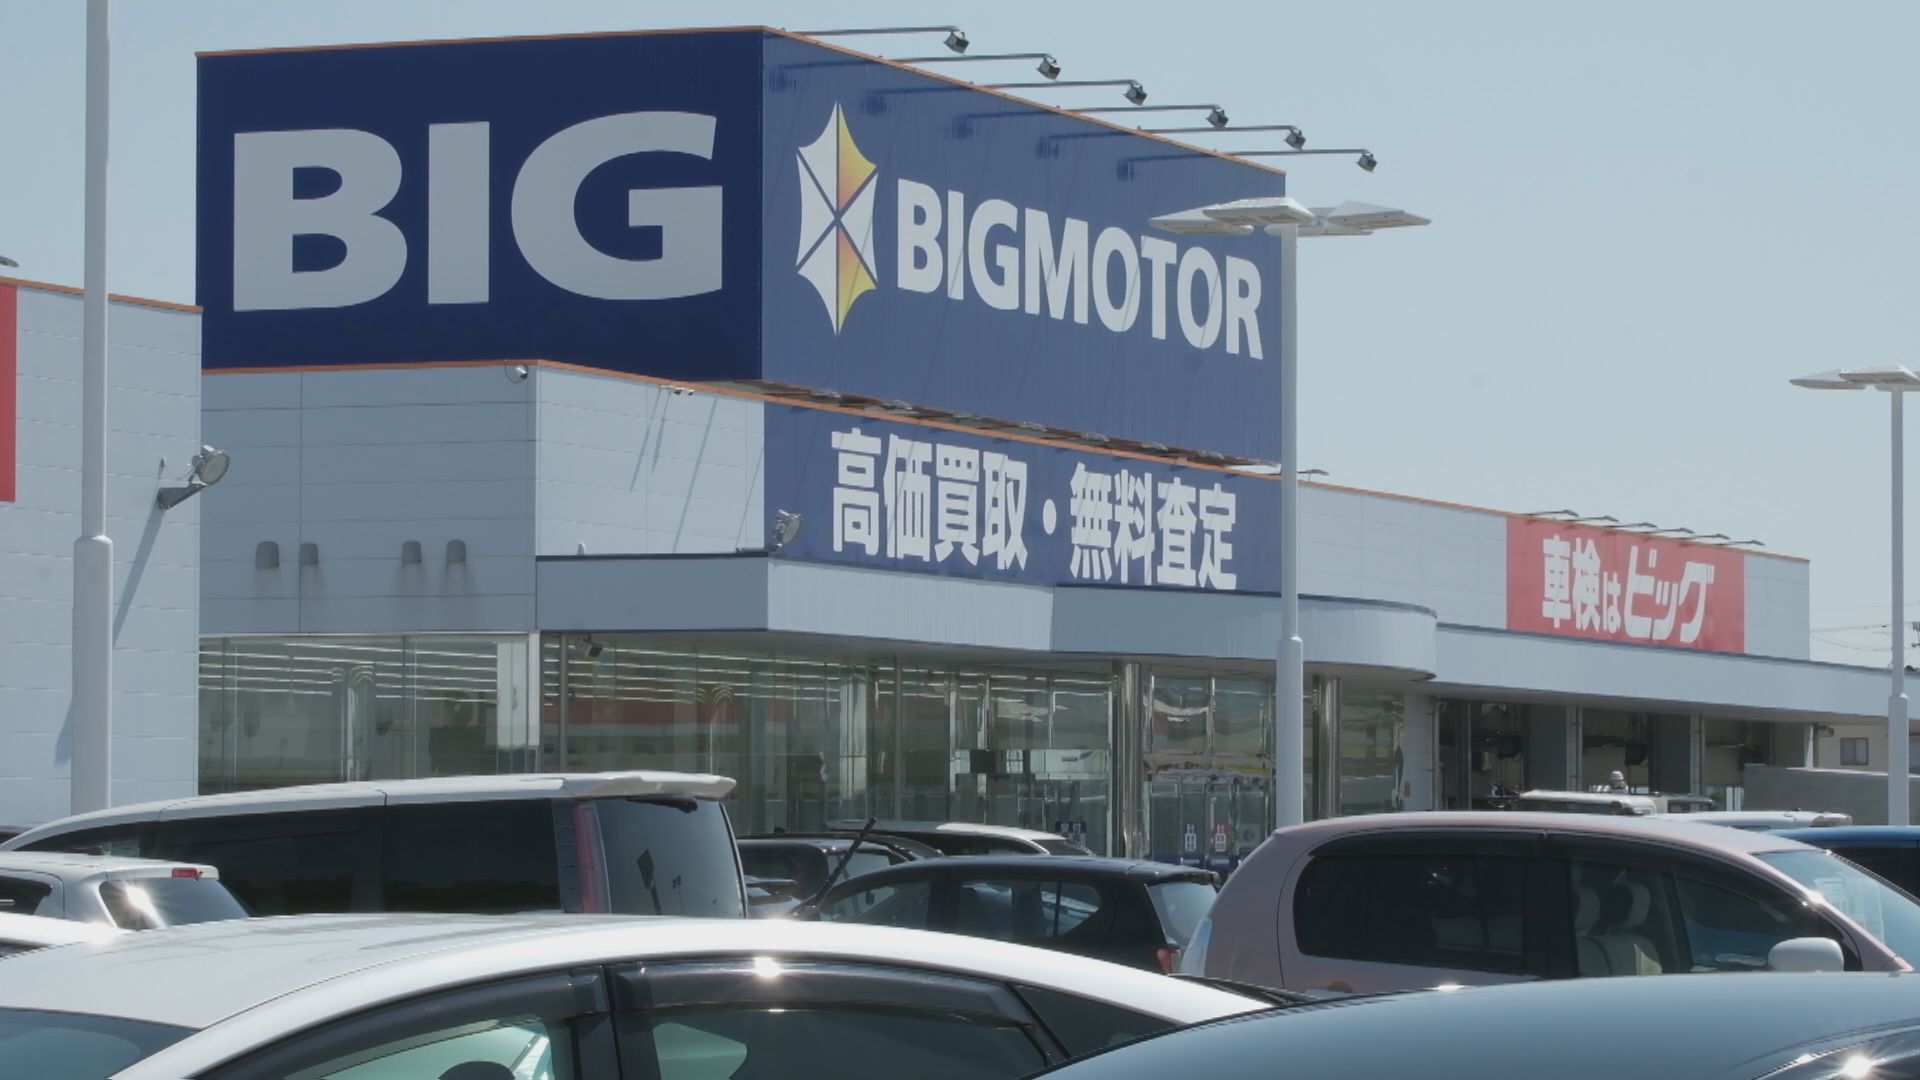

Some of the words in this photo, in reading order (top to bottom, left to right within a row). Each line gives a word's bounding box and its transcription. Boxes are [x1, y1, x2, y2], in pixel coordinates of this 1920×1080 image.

[233, 111, 723, 311] BIG
[897, 178, 1263, 360] BIGMOTOR
[831, 429, 1237, 590] 高価買取・無料査定
[1542, 534, 1715, 643] 車検はビッグ
